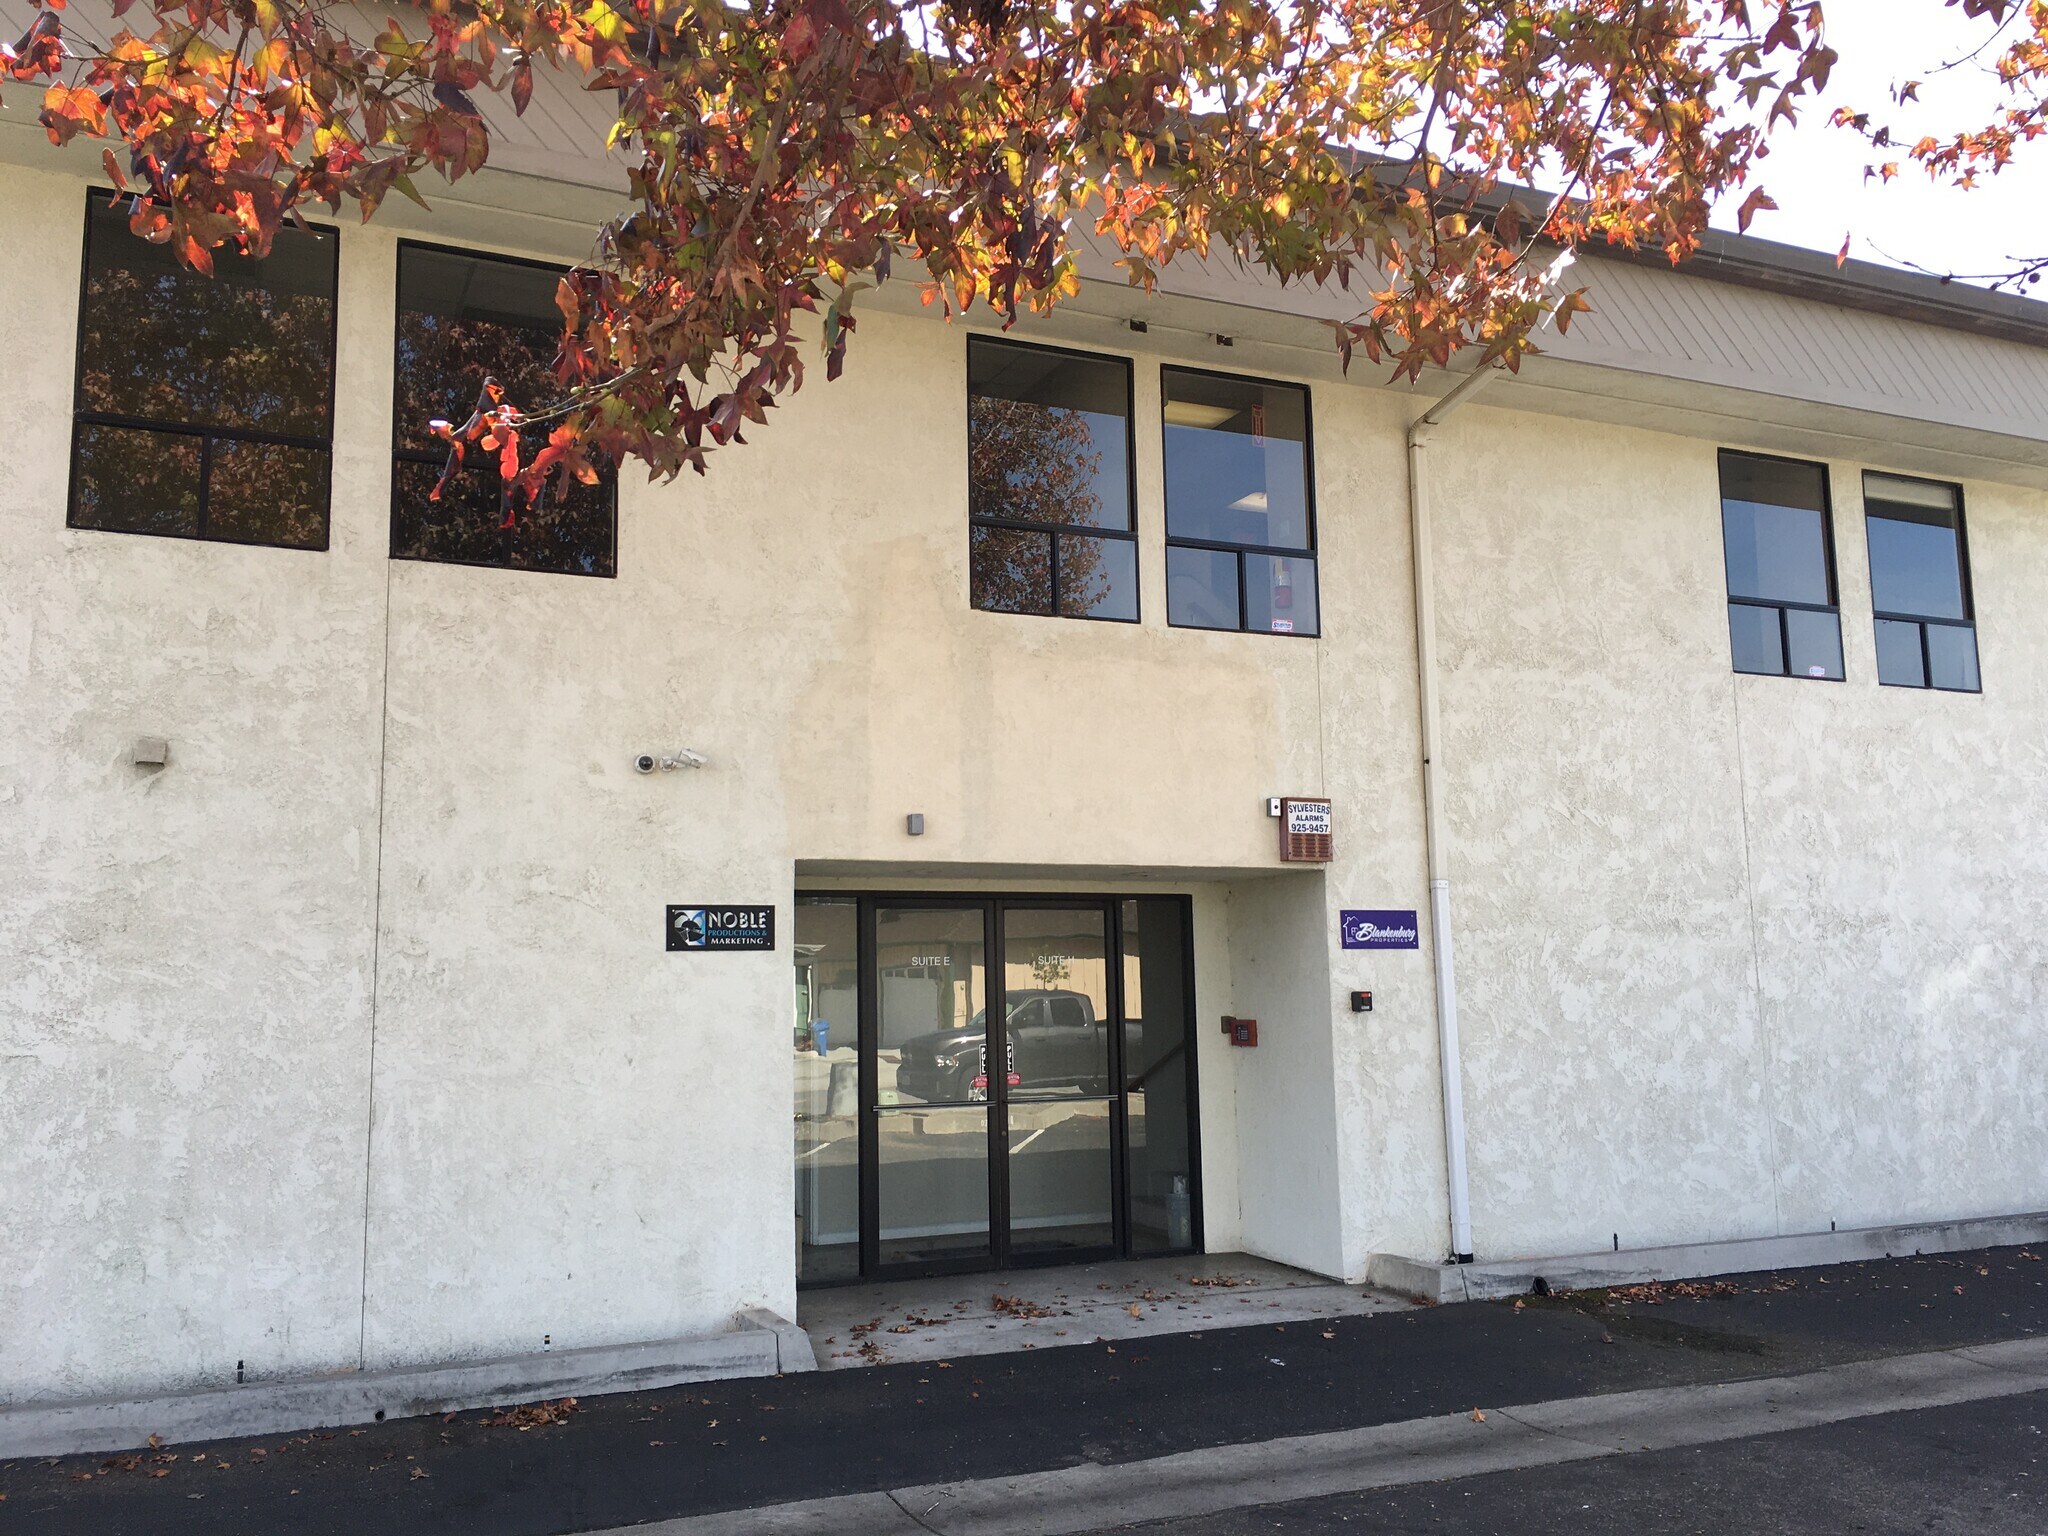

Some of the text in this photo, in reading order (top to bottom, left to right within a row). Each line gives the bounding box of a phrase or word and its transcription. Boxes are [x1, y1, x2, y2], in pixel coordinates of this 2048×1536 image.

[1288, 804, 1330, 815] SYLVESTERS
[1291, 824, 1329, 833] 925-9457
[708, 911, 766, 928] NOBLE
[1355, 923, 1416, 942] Blankenburg
[911, 956, 950, 966] SUITE E
[1037, 955, 1066, 965] SUITE
